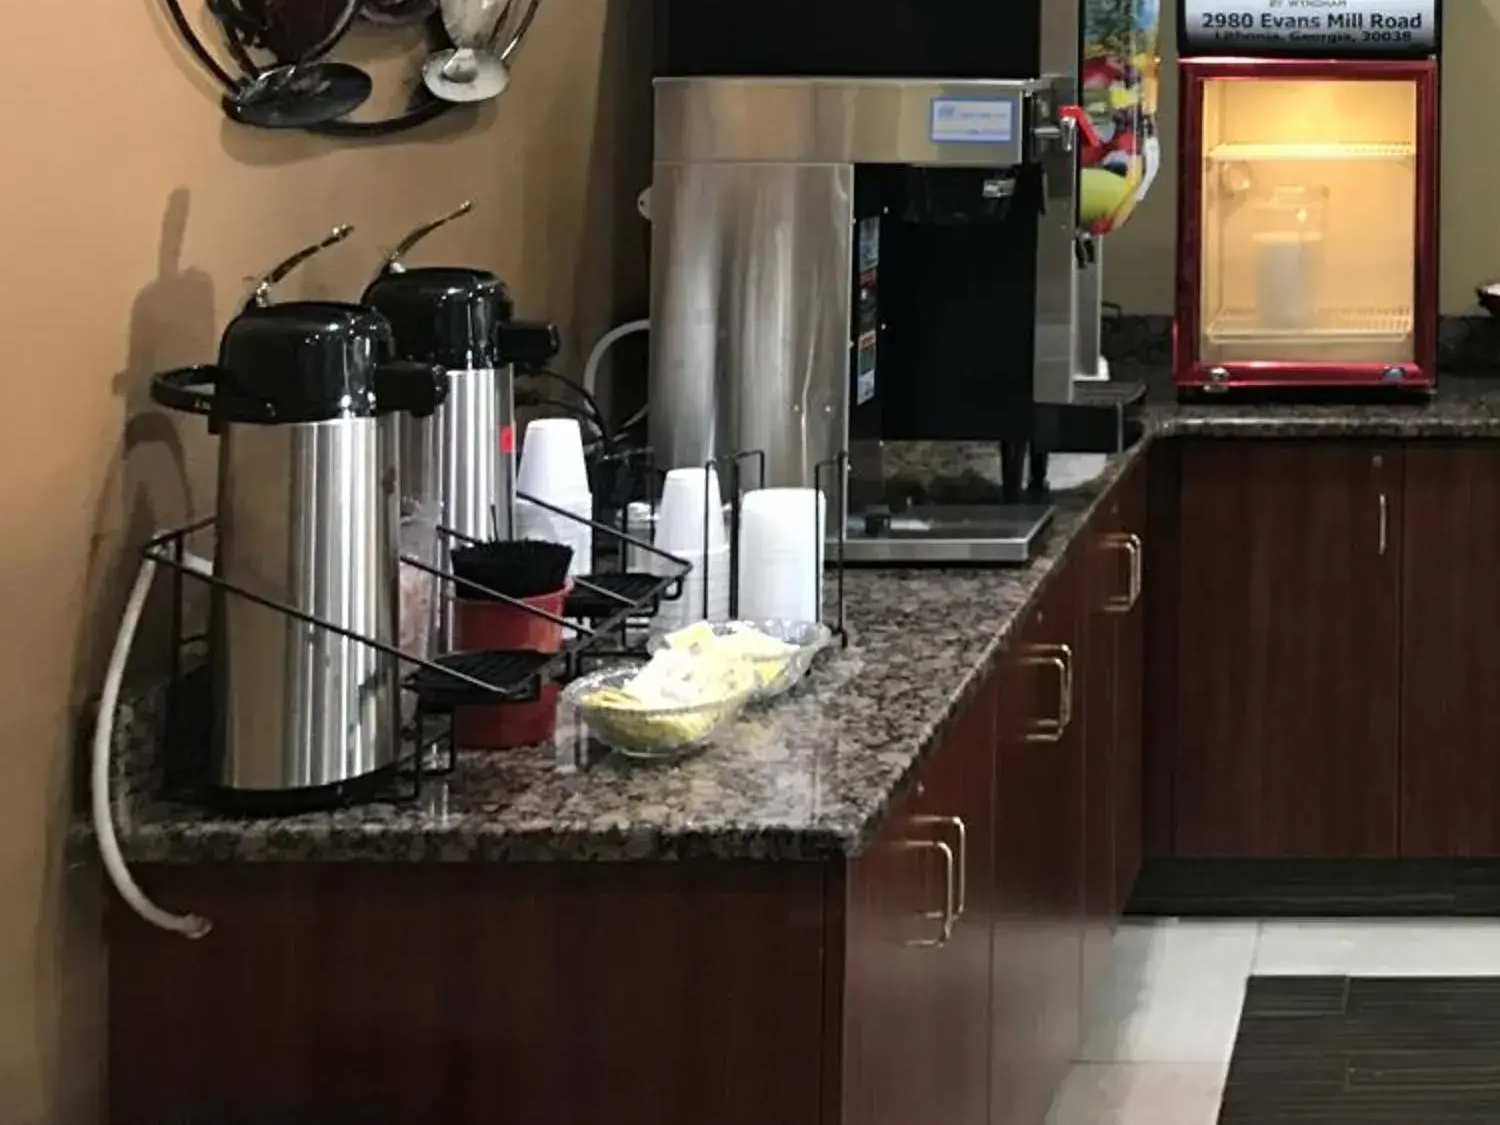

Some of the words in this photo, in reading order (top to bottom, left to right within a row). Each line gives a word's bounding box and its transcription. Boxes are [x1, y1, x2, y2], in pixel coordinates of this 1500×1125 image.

[1269, 0, 1283, 8] BY
[1288, 0, 1347, 8] WYNDHAM
[1201, 12, 1253, 29] 2980
[1260, 13, 1321, 29] Evans
[1327, 13, 1363, 29] Mill
[1370, 13, 1422, 29] Road
[1288, 31, 1356, 44] Georgia,
